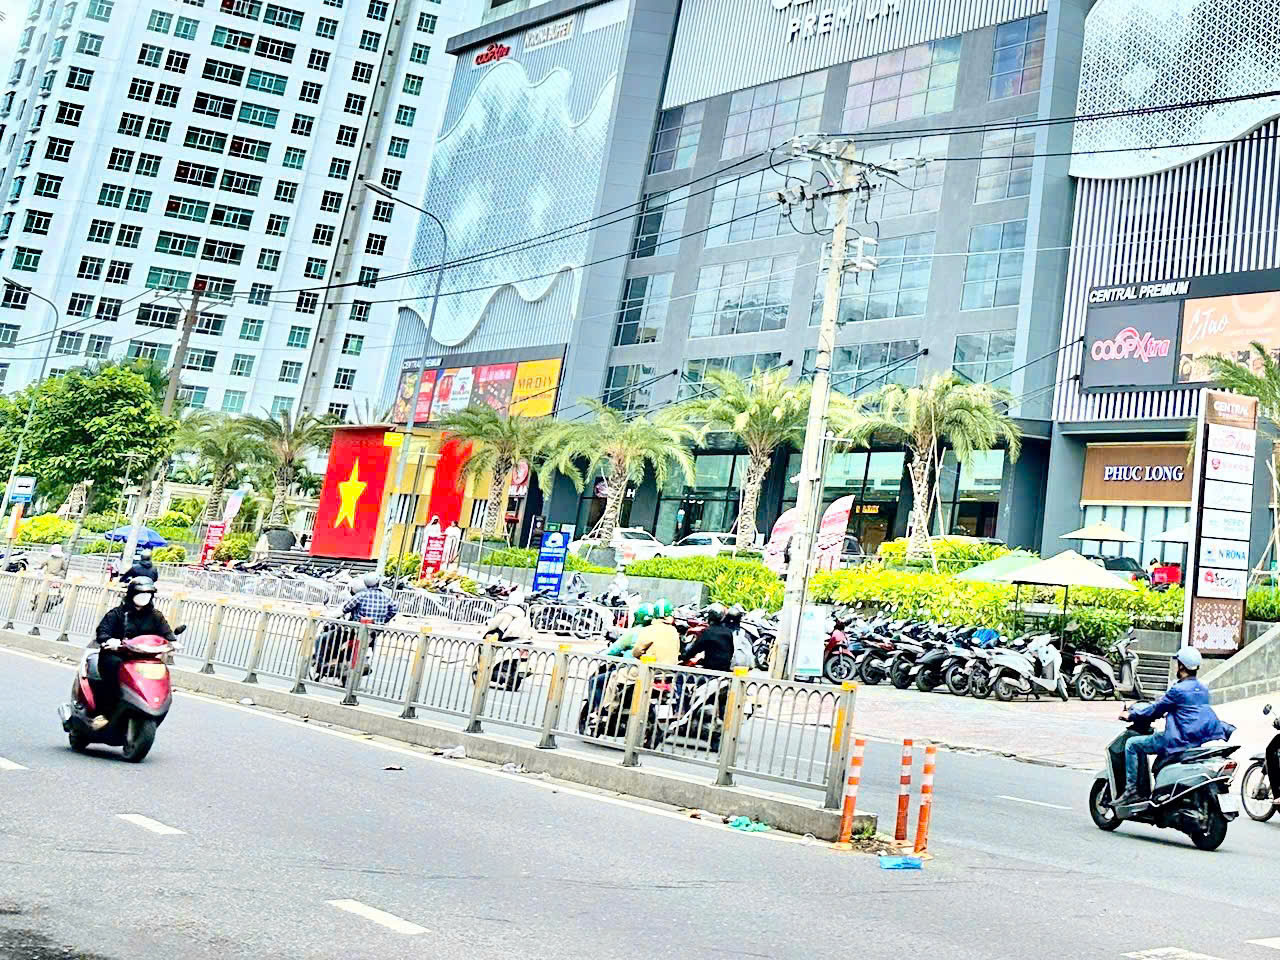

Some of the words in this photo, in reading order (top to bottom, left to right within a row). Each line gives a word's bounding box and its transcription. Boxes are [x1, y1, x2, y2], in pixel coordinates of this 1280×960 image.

[1088, 285, 1138, 303] CENTRAL
[1139, 281, 1190, 299] PREMIUM
[402, 360, 420, 369] CENTRA
[1103, 465, 1144, 481] PHUC
[1145, 465, 1184, 481] LONG
